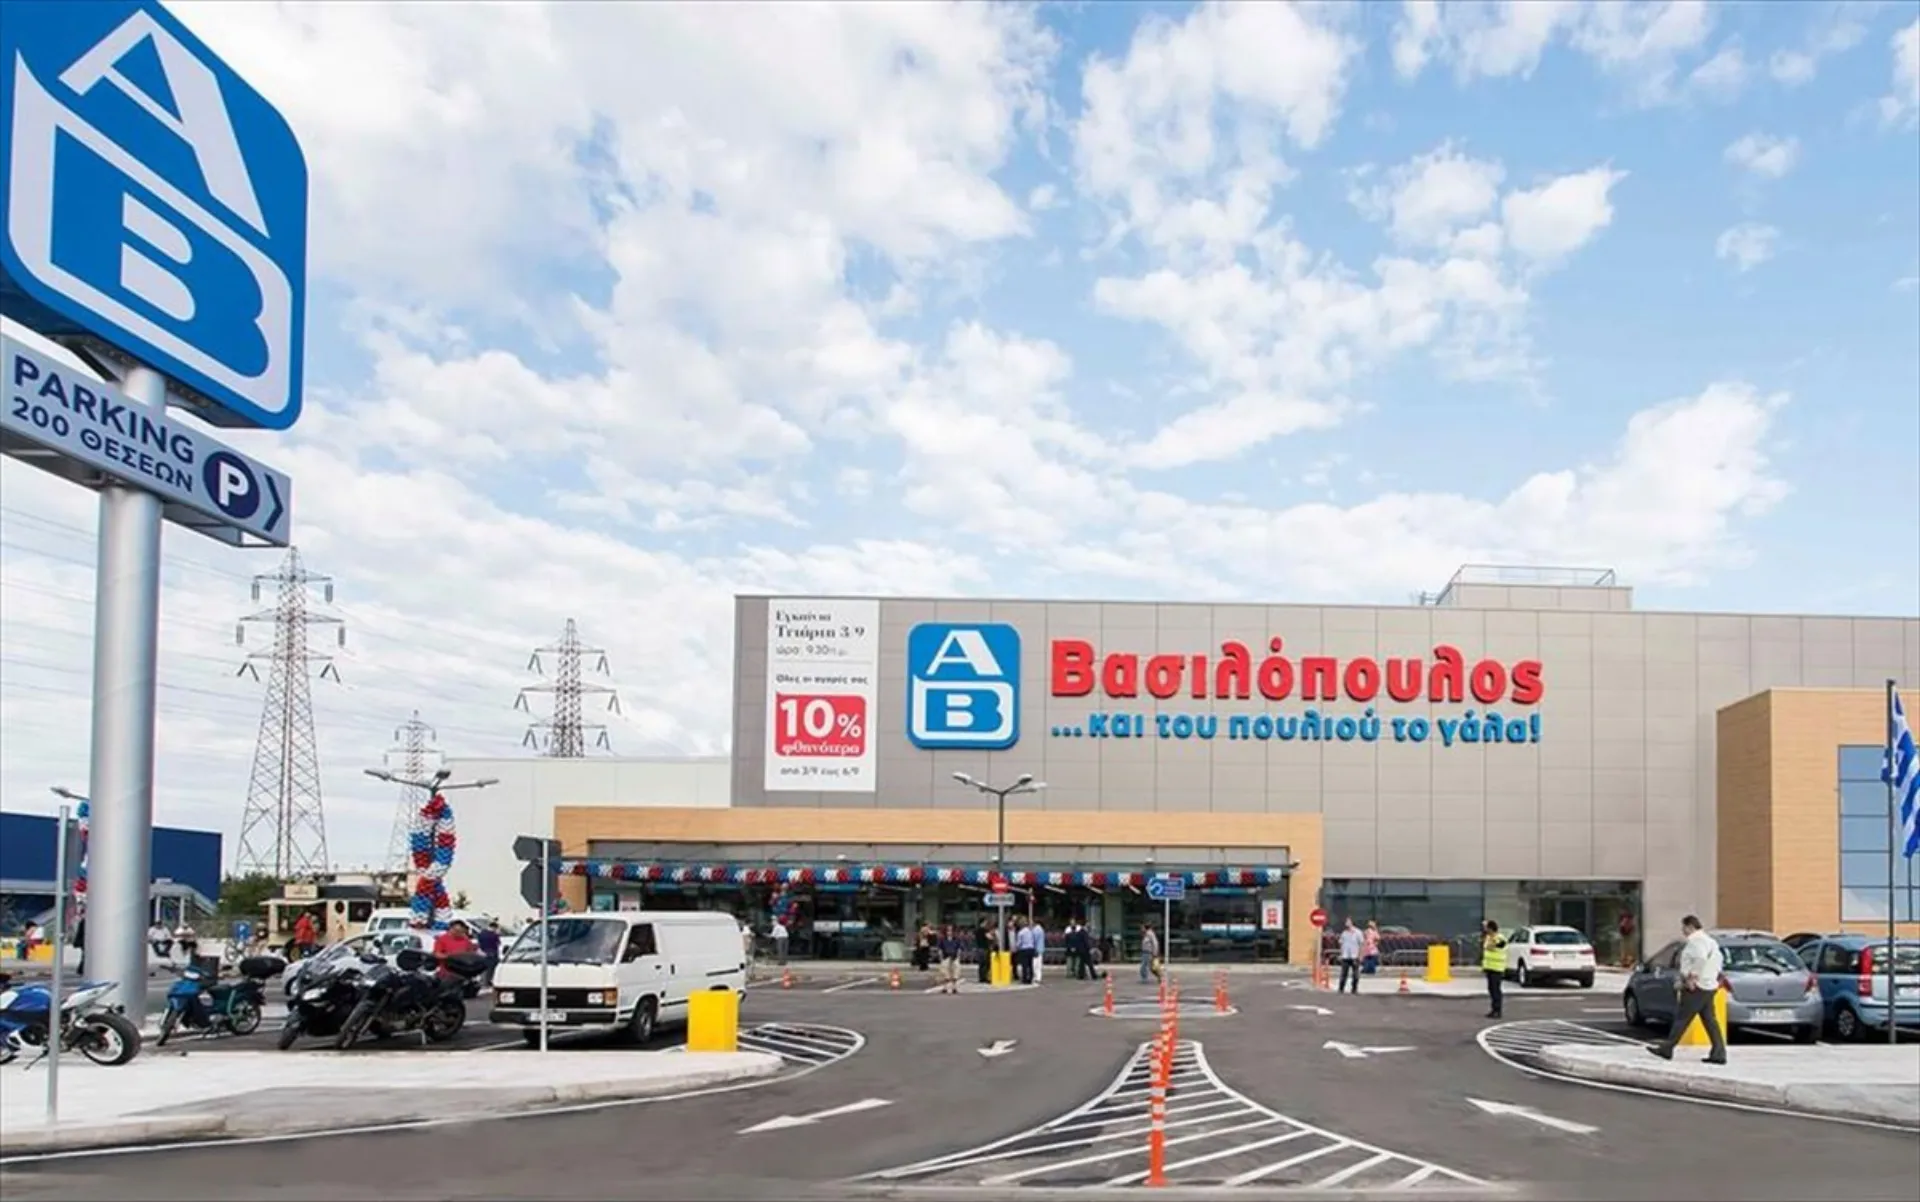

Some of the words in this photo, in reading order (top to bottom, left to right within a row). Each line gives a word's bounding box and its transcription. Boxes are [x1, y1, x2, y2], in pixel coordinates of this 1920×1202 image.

[14, 354, 194, 465] PARKING
[12, 397, 69, 438] 200
[80, 428, 193, 493] ΘΕΣΕΩΝ
[218, 460, 250, 507] P
[1051, 636, 1545, 705] Βασιλόπουλος
[780, 698, 862, 738] 10%
[1155, 713, 1218, 740] του
[1228, 707, 1381, 742] πουλιού
[1391, 717, 1430, 742] το
[1437, 709, 1542, 747] γάλα!
[781, 740, 861, 757] φθηνότερα
